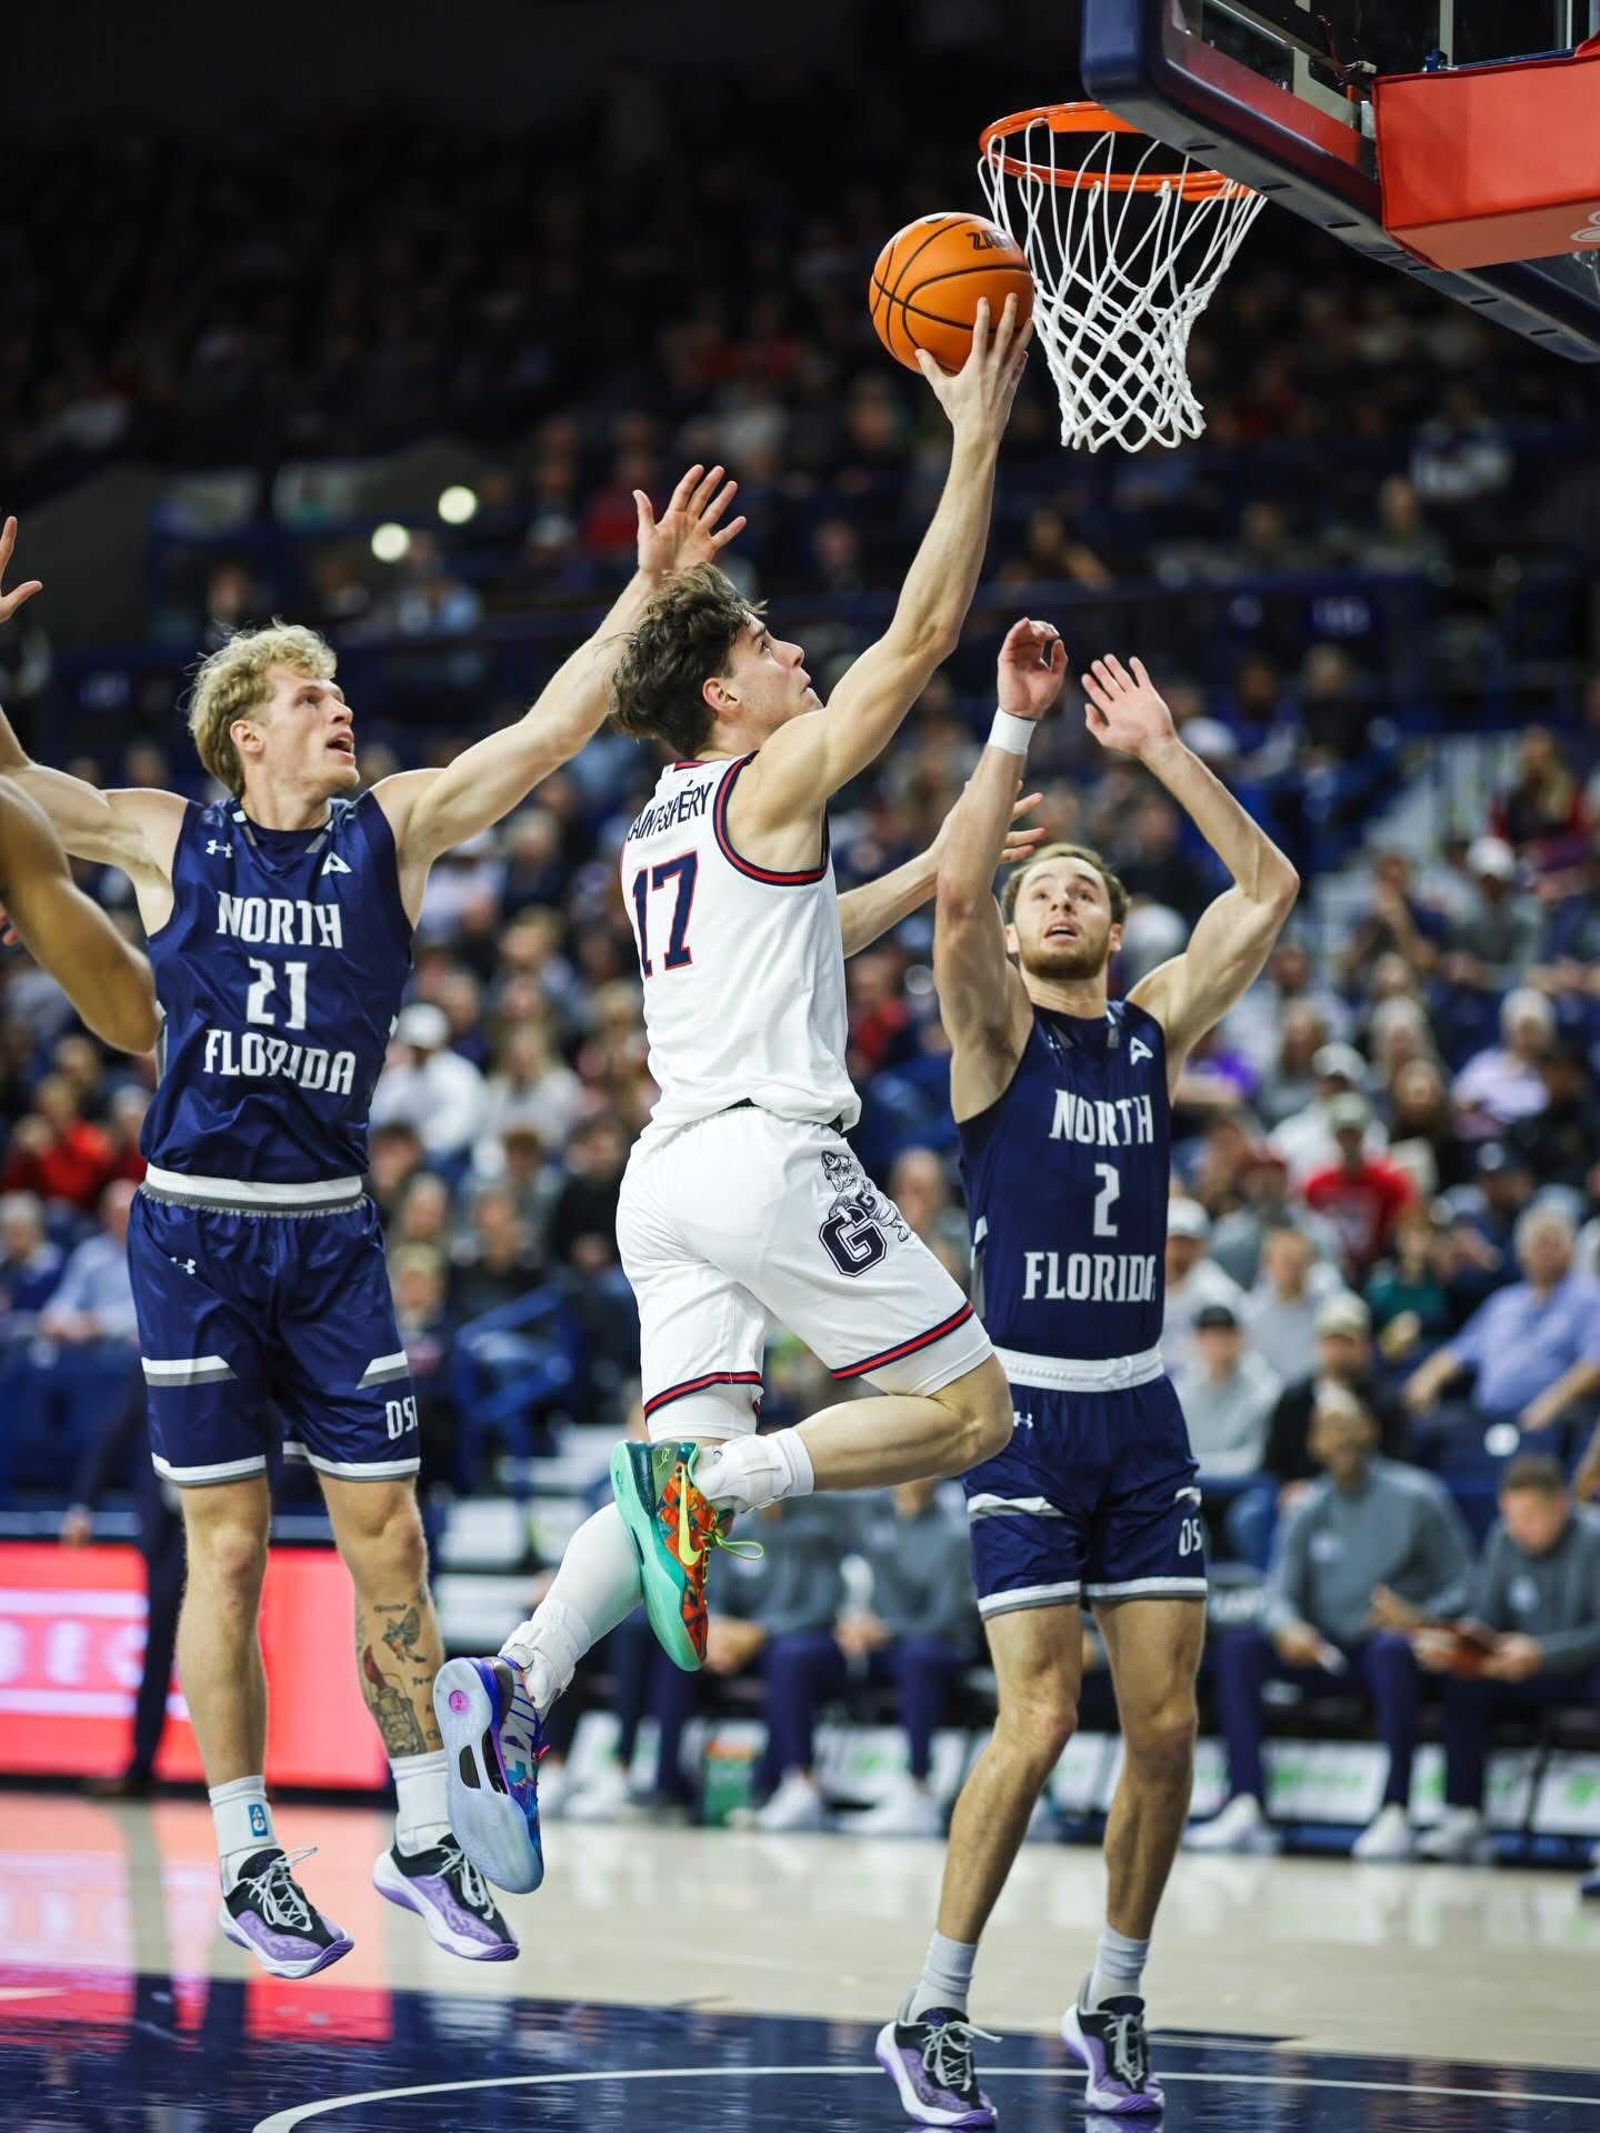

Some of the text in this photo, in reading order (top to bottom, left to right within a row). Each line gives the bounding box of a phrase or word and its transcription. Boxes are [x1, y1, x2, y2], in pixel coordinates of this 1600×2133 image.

[216, 890, 342, 948] NORTH
[632, 850, 698, 979] 17
[246, 957, 308, 1030] 21
[203, 1029, 356, 1095] FLORIDA
[1049, 1089, 1154, 1147] NORTH
[1093, 1162, 1120, 1236] 2
[819, 1204, 888, 1277] G
[386, 1395, 418, 1440] OS
